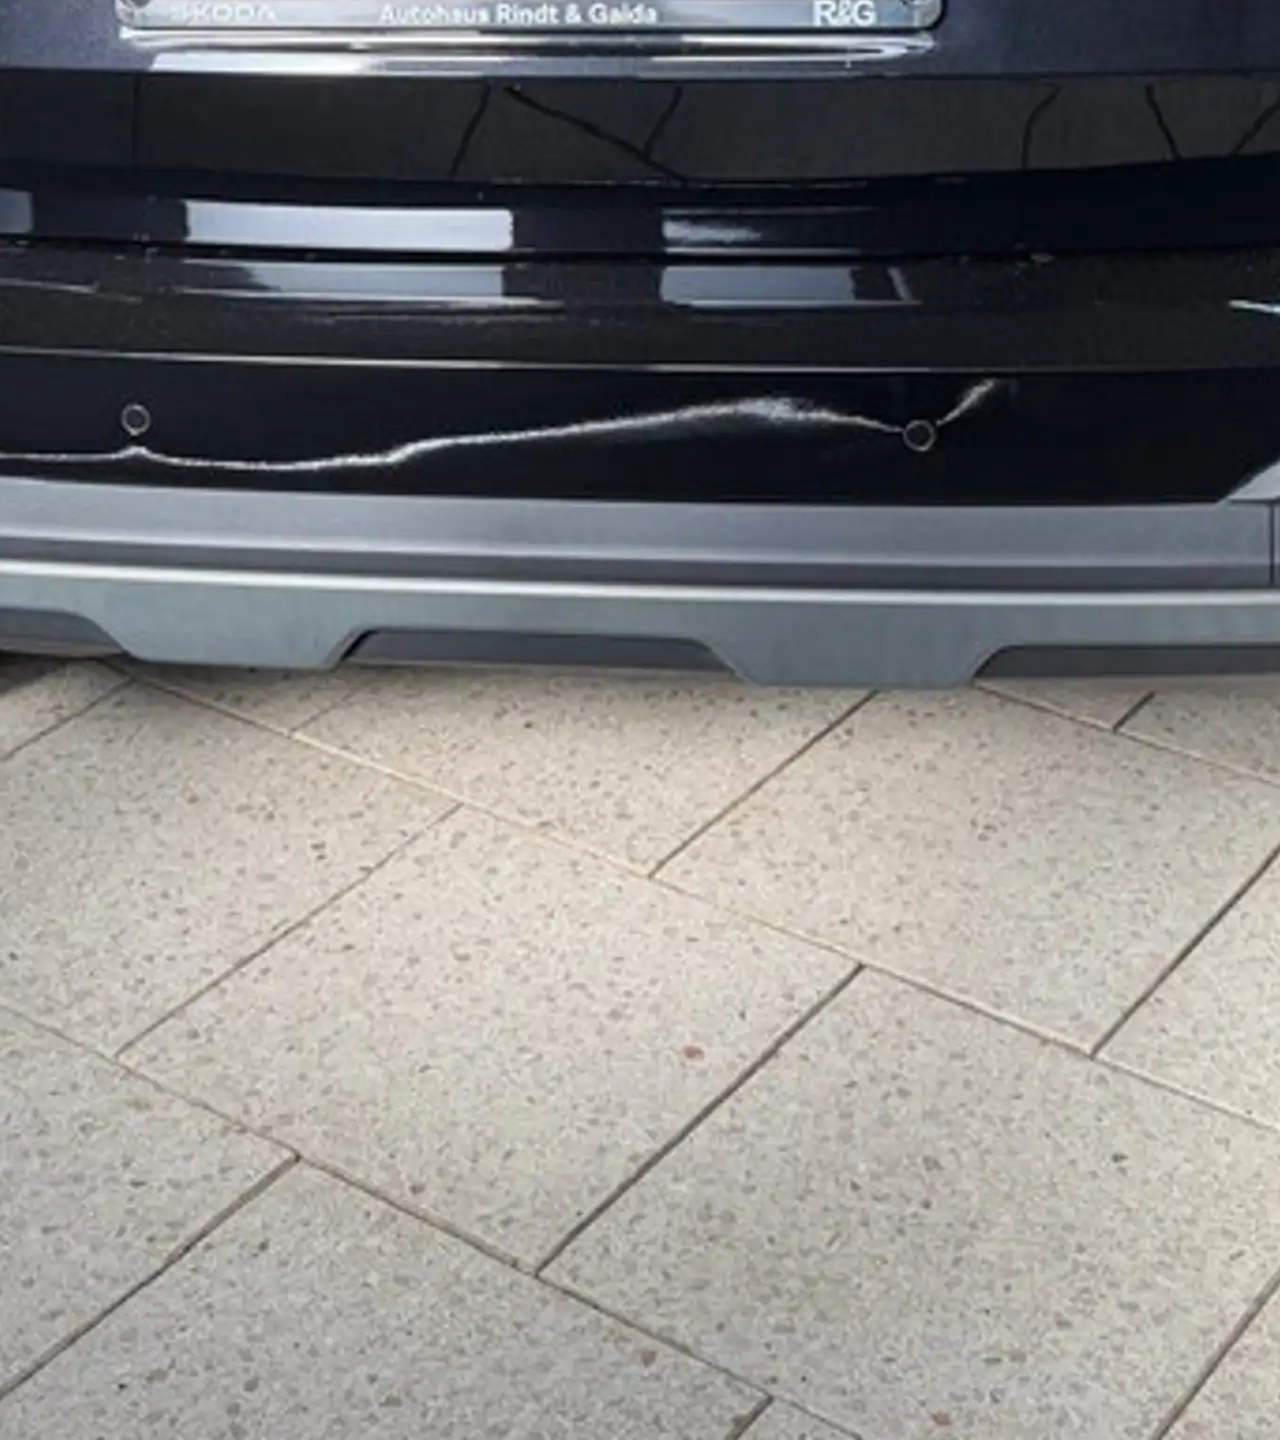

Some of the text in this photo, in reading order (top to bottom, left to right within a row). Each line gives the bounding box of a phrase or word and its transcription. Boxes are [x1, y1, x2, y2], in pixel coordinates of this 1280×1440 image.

[379, 3, 490, 25] Autohaus
[496, 2, 560, 25] Rindt
[565, 4, 583, 24] &
